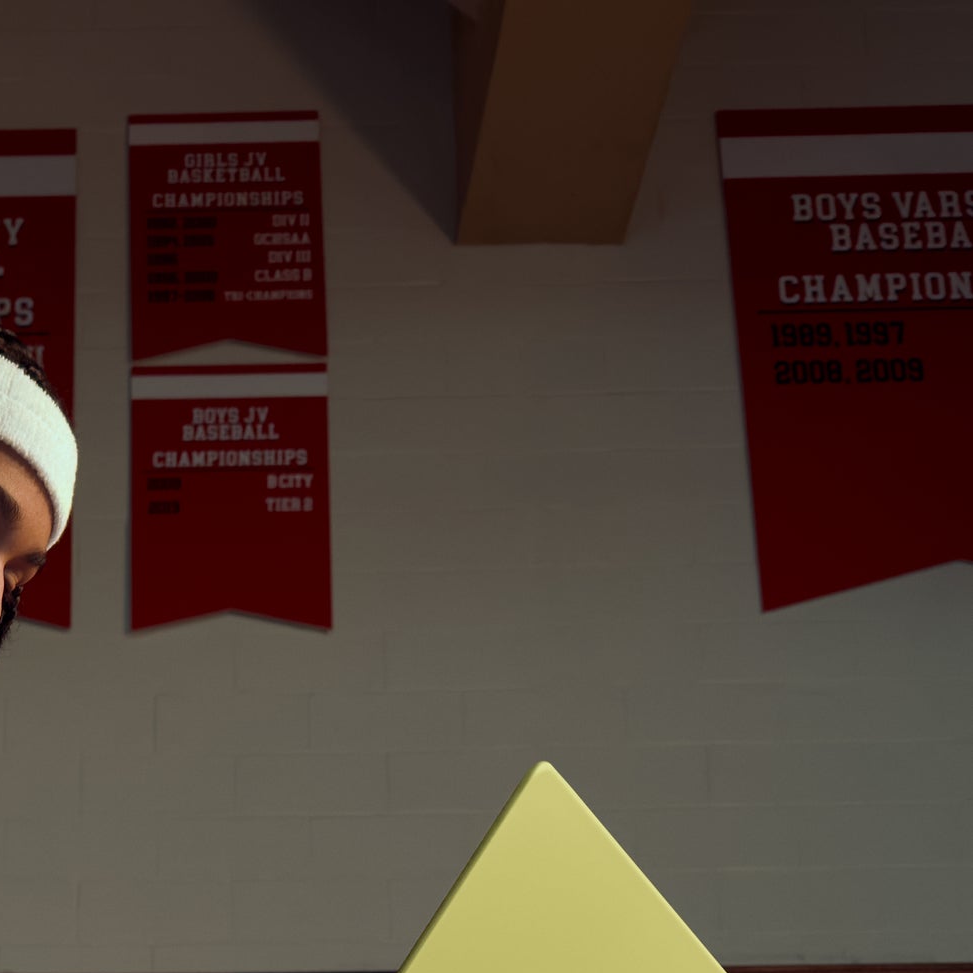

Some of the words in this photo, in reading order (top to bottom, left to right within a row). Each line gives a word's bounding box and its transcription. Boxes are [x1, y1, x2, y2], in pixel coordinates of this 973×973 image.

[183, 152, 239, 169] GIRLS
[243, 151, 267, 167] JV
[167, 166, 287, 185] BASKETBALL
[151, 190, 305, 209] CHAMPIONSHIPS
[790, 192, 883, 221] BOYS
[828, 220, 973, 251] BASEBA
[253, 268, 301, 283] CLASS
[843, 320, 905, 346] 1997
[855, 357, 925, 383] 2009
[191, 406, 240, 424] BOYS
[243, 405, 270, 422] JV
[182, 422, 281, 442] BASEBALL
[151, 448, 309, 469] CHAMPIONSHIPS
[278, 473, 314, 489] CITY
